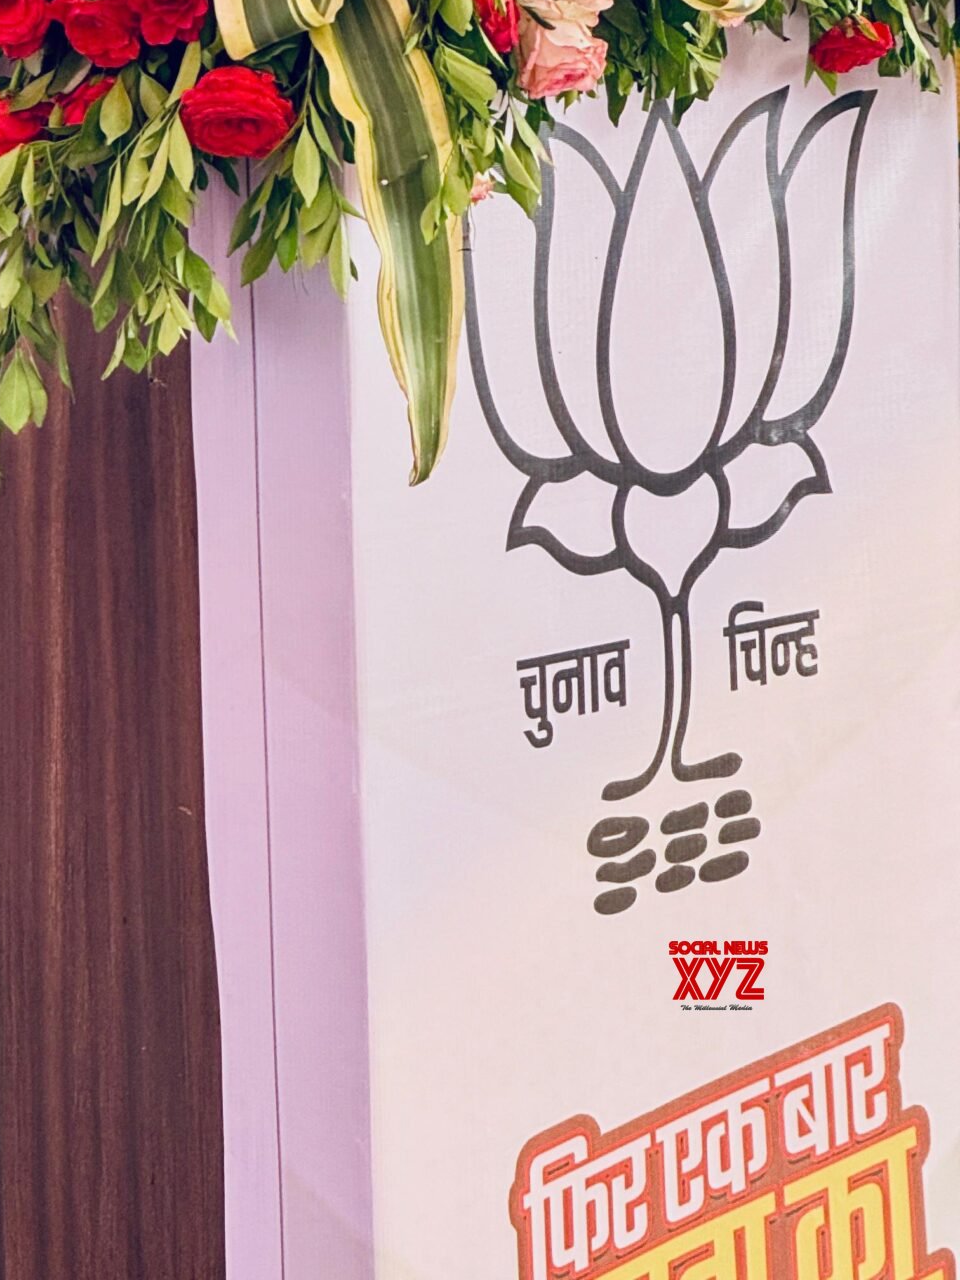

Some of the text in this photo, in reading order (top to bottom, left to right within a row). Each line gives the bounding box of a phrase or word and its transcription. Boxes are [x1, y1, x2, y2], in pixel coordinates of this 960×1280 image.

[516, 600, 820, 748] चुनाव चिन्ह
[523, 1135, 651, 1280] फिर
[656, 1077, 770, 1223] एक
[774, 1022, 891, 1156] बार
